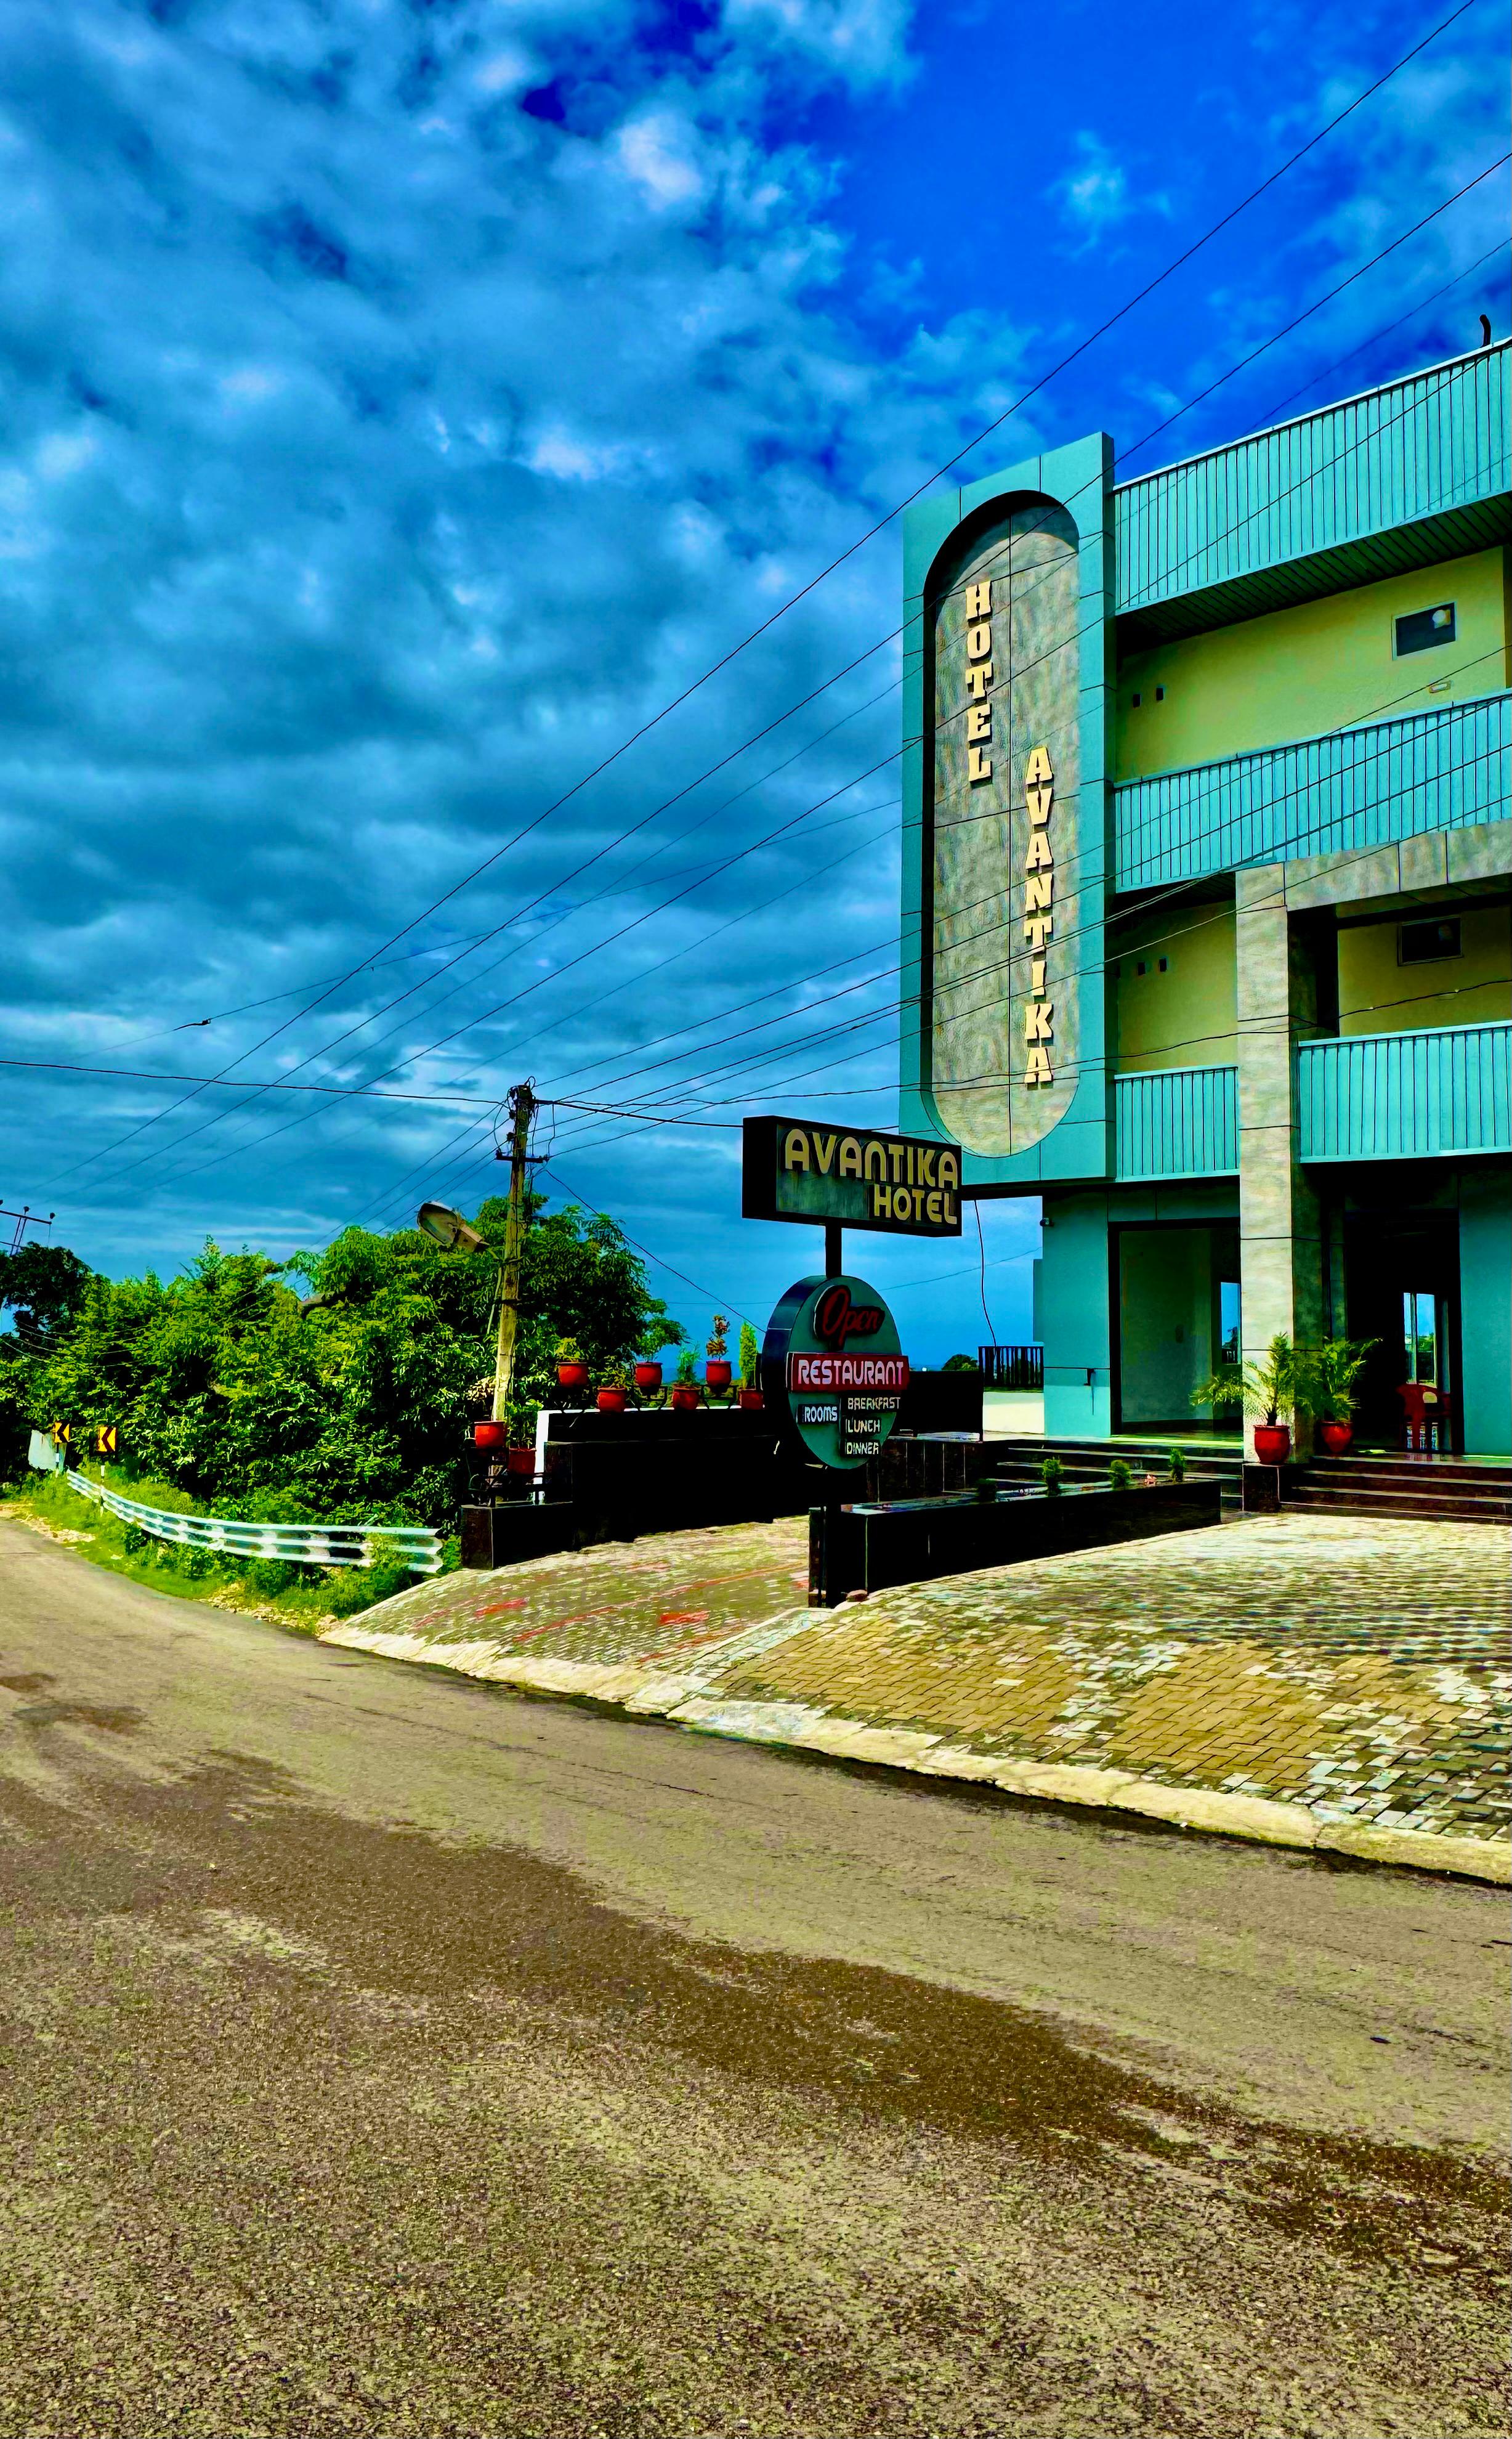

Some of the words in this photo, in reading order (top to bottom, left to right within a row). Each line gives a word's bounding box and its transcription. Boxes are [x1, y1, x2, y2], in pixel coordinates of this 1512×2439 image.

[965, 580, 993, 782] HOTEL
[1024, 745, 1053, 1085] AVANTIKA
[784, 1128, 958, 1190] AVANTIKA
[873, 1183, 958, 1225] HOTEL
[822, 1288, 880, 1347] Open
[798, 1359, 904, 1386] RESTAURANT
[804, 1406, 838, 1422] ROOMS
[847, 1396, 901, 1411] BREAKFAST
[846, 1419, 881, 1434] LUNCH
[846, 1441, 879, 1455] DINNER
